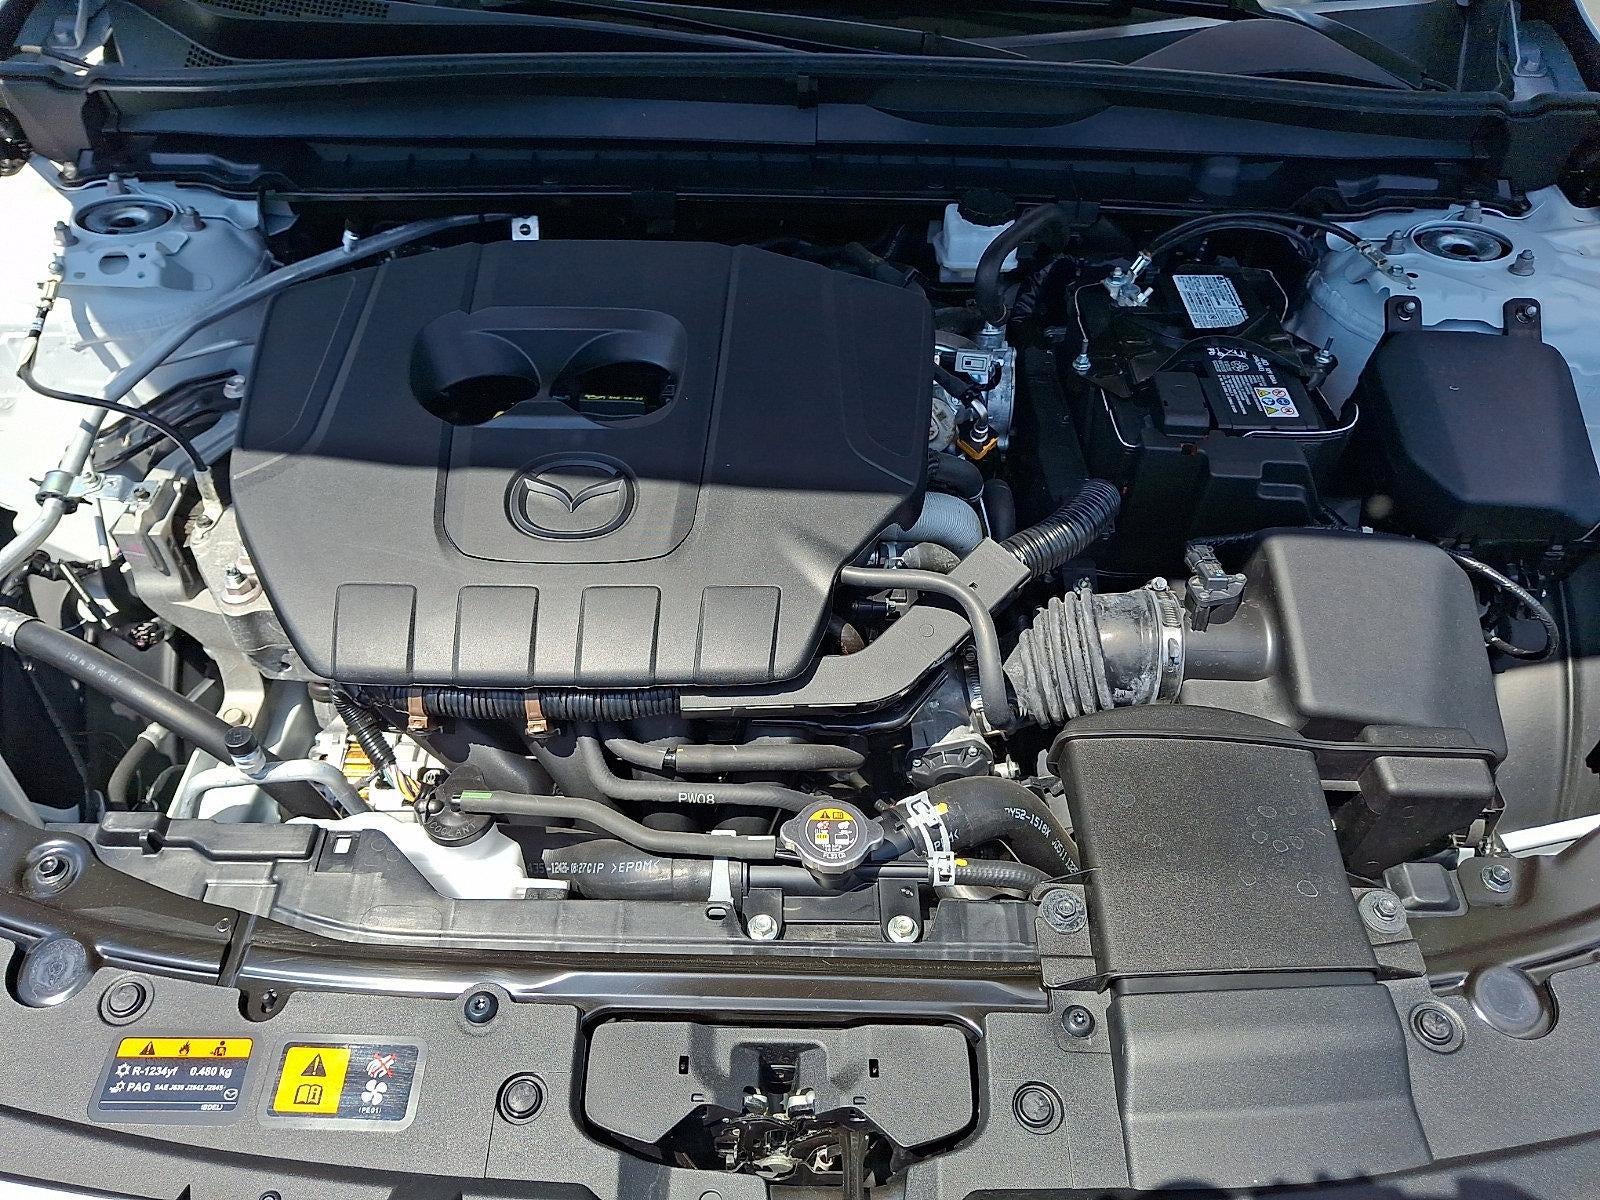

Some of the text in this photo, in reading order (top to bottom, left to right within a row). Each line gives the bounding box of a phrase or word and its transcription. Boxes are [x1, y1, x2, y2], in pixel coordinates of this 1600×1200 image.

[678, 792, 715, 804] PW08
[430, 820, 476, 837] COOLANT
[132, 1066, 233, 1078] R-1234yf 0.480 kg
[126, 1082, 151, 1092] PAG
